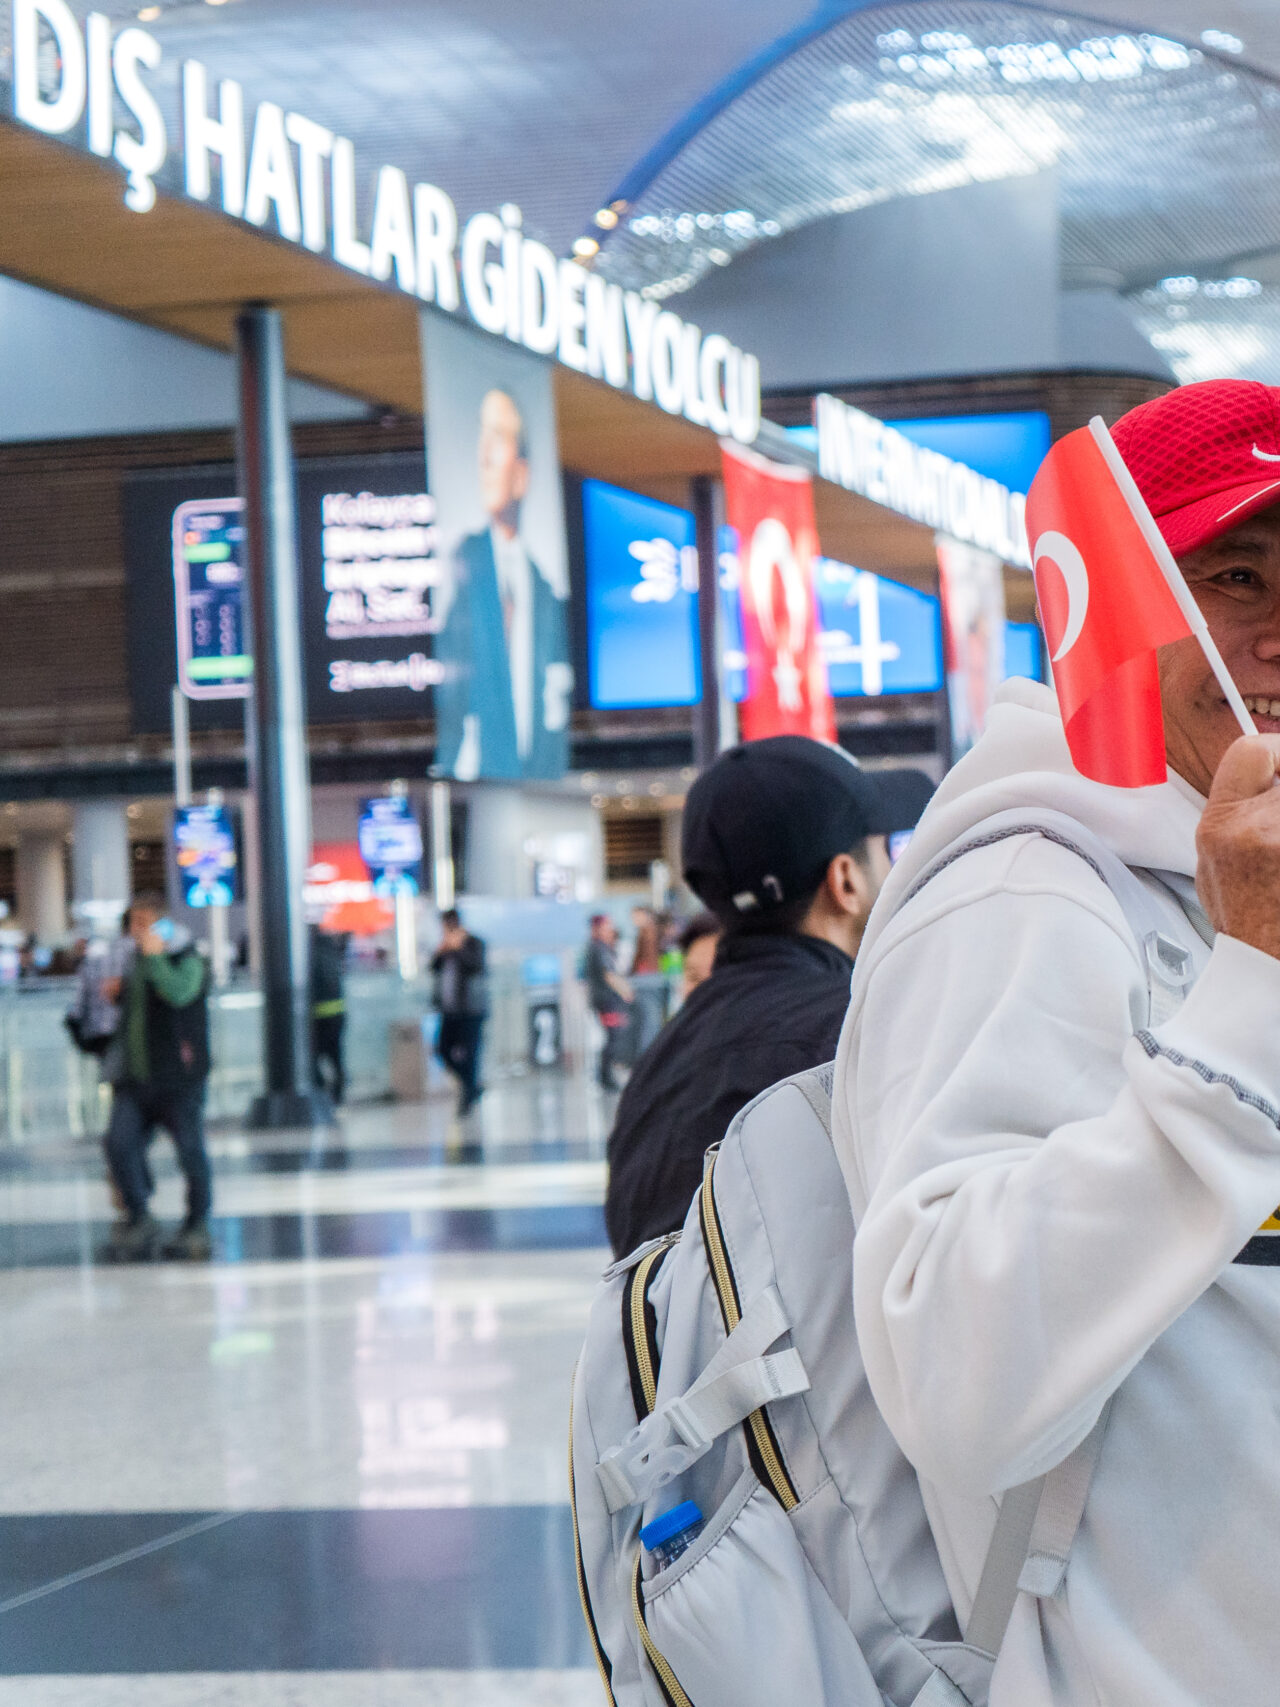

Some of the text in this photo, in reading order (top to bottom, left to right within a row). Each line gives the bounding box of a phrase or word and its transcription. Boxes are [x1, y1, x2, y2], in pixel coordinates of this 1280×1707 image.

[13, 0, 762, 444] DIŞ HATLAR GİDEN YOLCU
